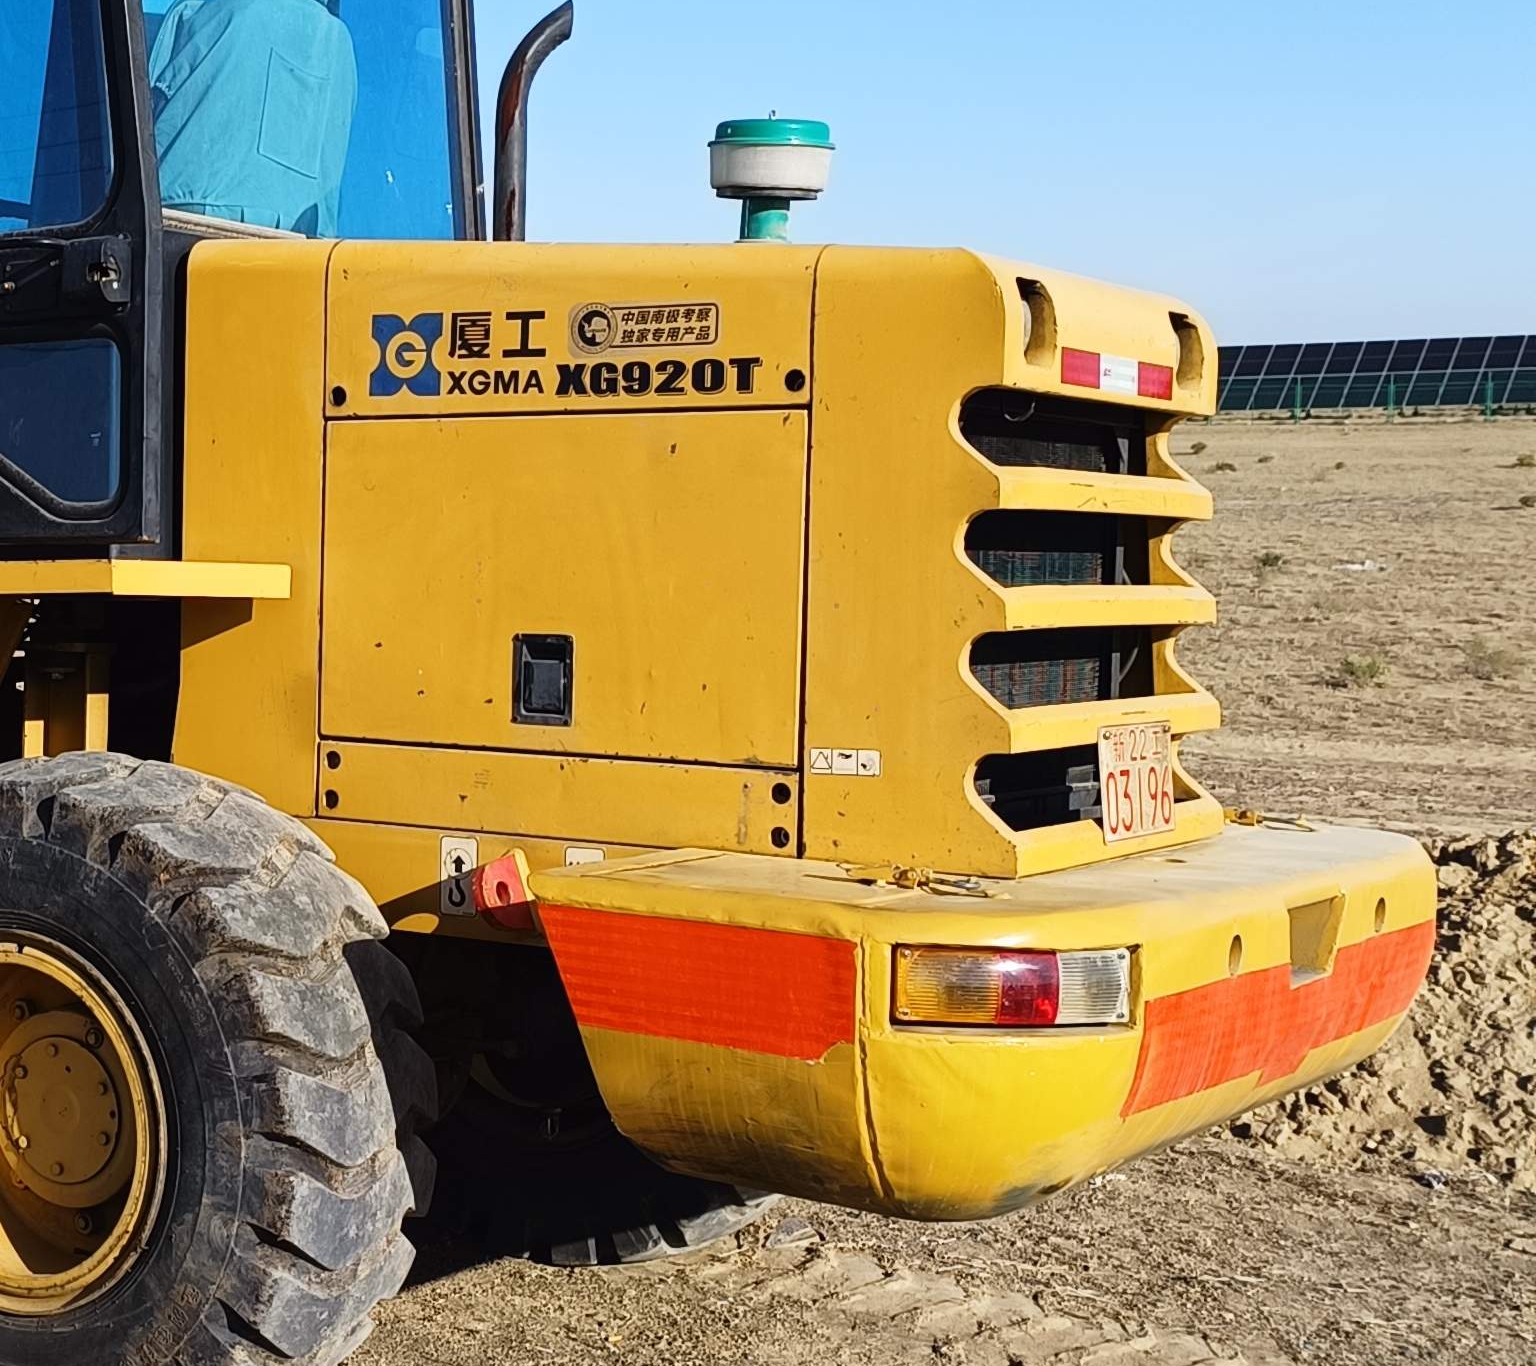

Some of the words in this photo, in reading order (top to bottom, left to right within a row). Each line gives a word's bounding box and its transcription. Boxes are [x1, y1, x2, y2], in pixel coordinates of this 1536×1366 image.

[448, 310, 547, 359] 厦工
[620, 325, 711, 344] 独家专用产品
[621, 307, 712, 326] 中国南极考察
[446, 369, 545, 395] XGMA
[555, 357, 764, 397] XG920T
[1106, 766, 1172, 834] 03196
